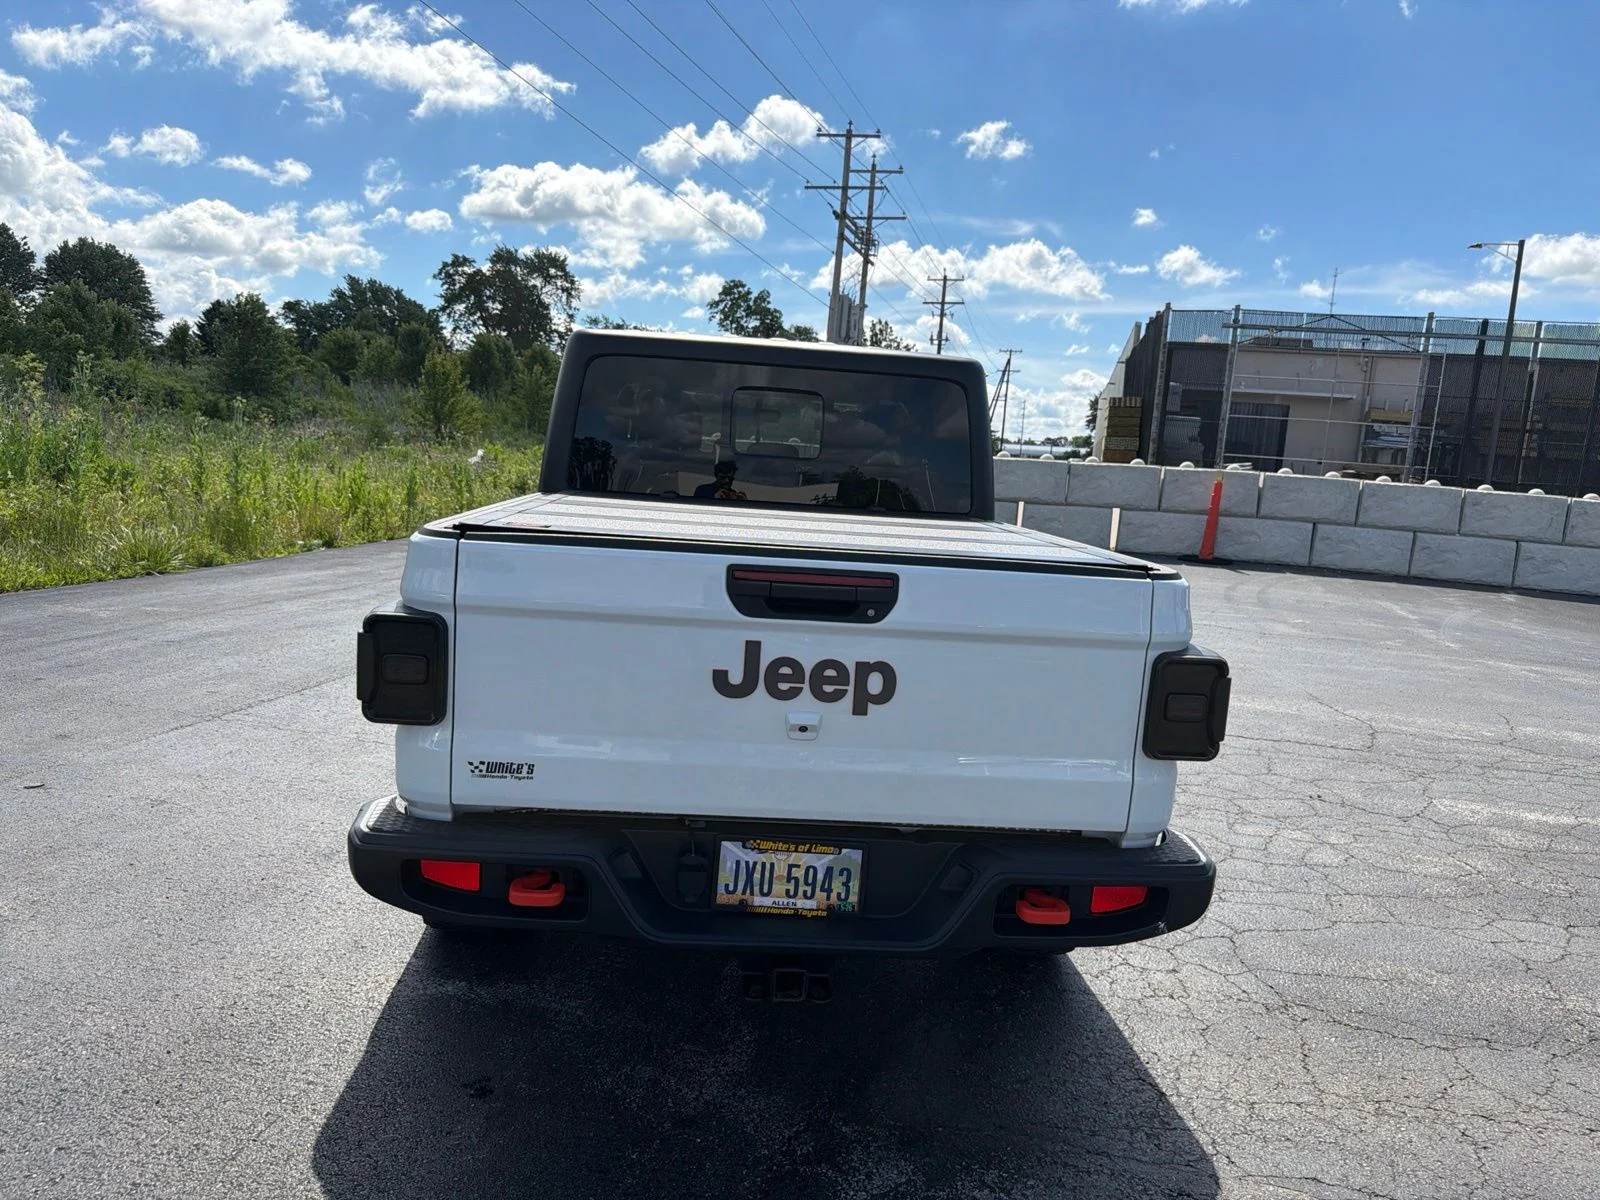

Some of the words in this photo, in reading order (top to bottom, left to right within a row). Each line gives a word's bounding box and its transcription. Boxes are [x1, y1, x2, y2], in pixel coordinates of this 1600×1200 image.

[712, 639, 897, 716] Jeep
[485, 761, 535, 775] White's
[759, 840, 795, 851] White's
[797, 843, 809, 852] of
[724, 860, 775, 897] JXU
[785, 864, 852, 902] 5943
[767, 907, 794, 915] Honda
[798, 909, 828, 917] Toyota
